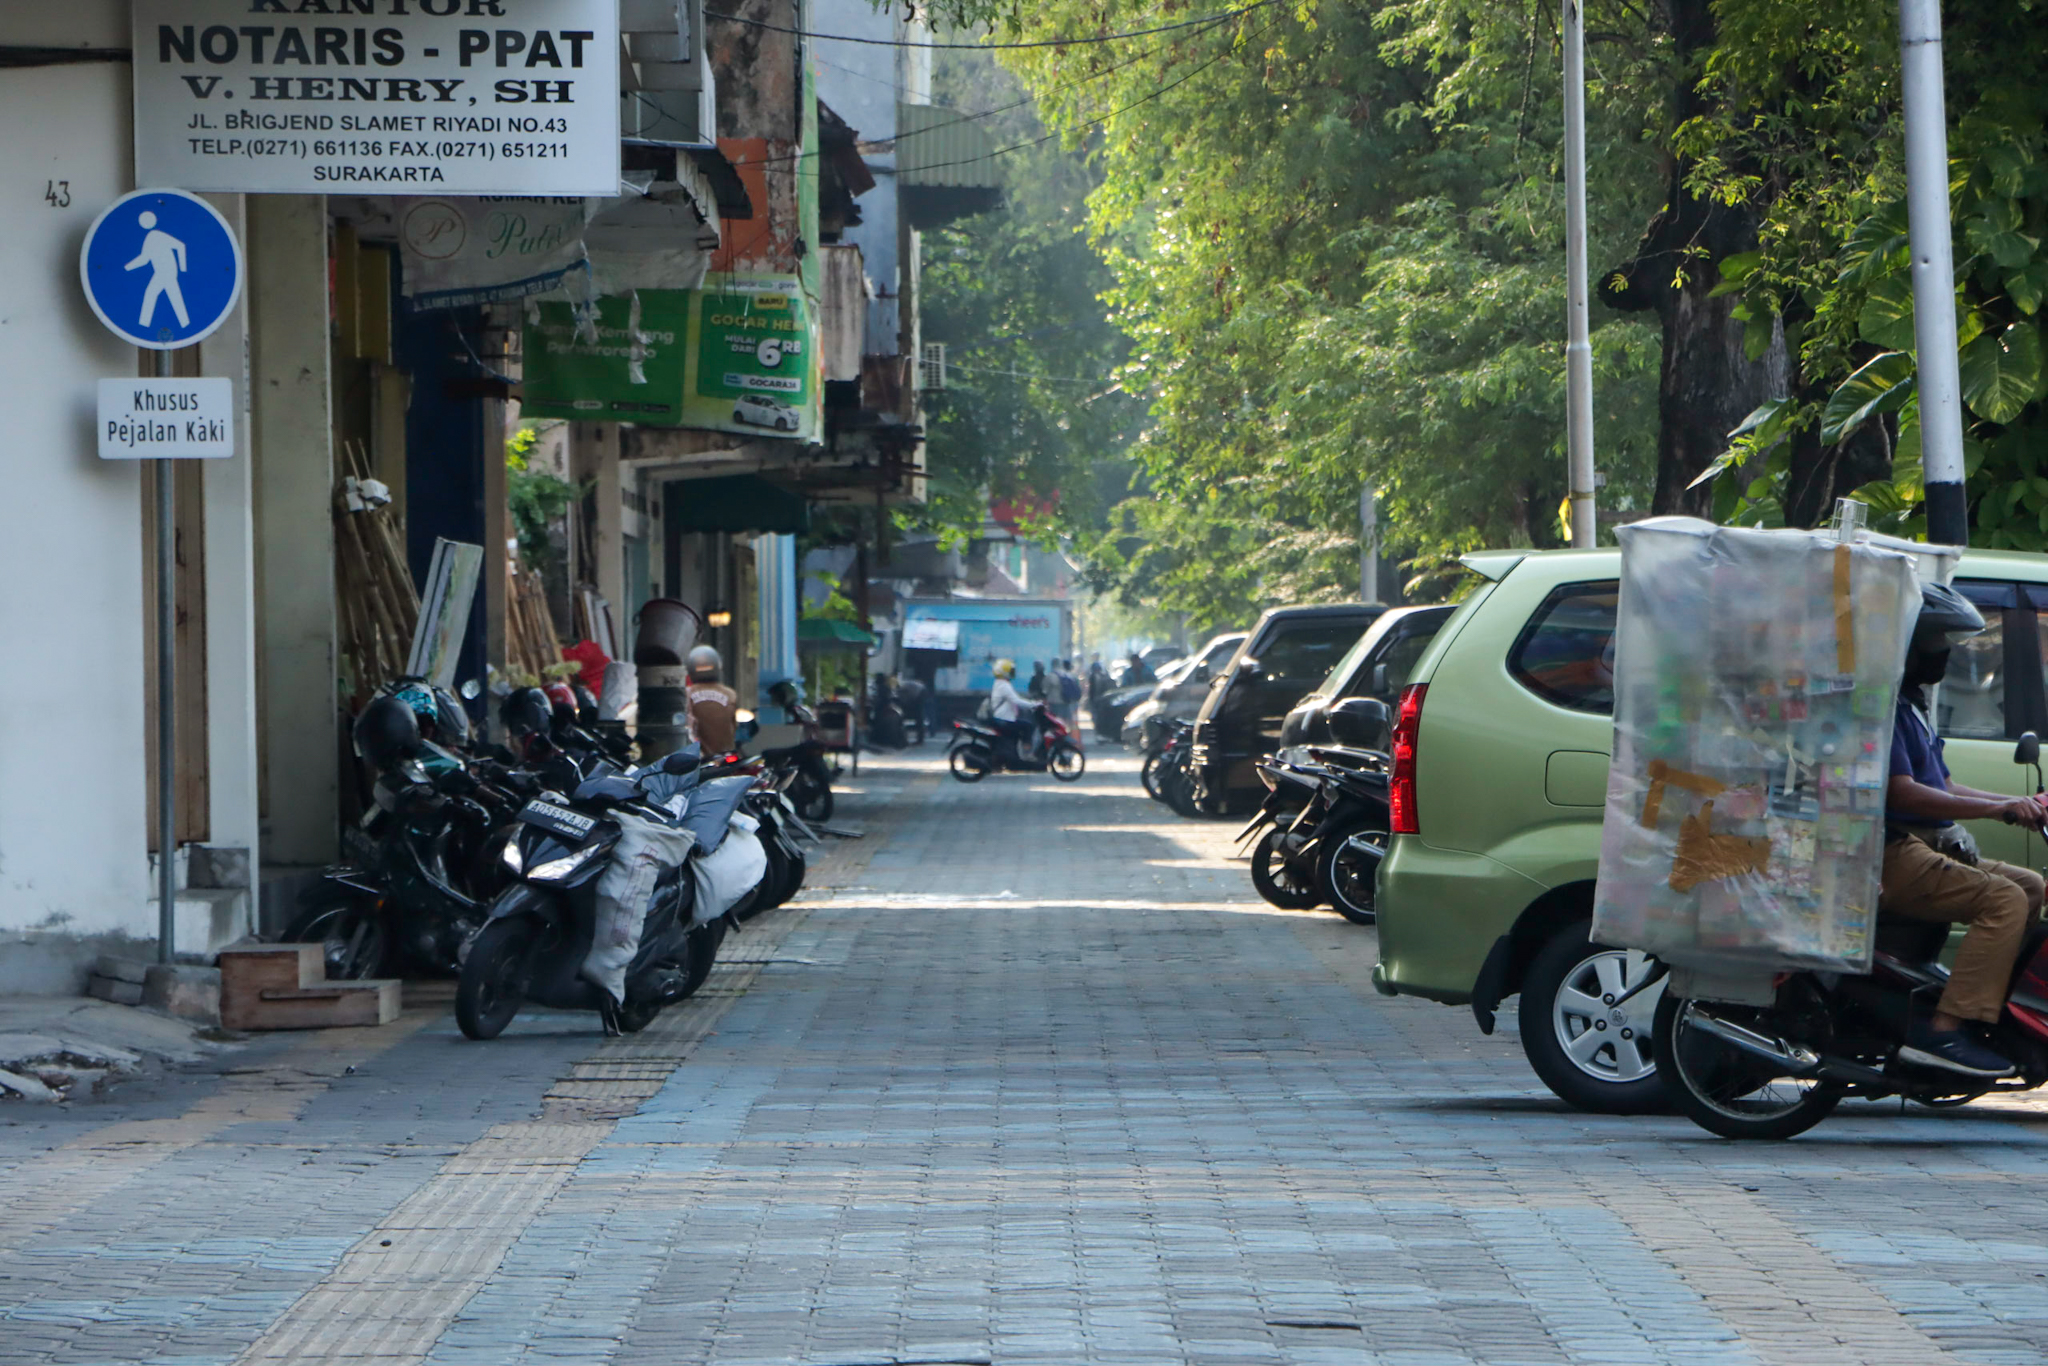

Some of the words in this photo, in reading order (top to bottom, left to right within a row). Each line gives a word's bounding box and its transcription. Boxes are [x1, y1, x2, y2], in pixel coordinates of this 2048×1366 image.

[158, 24, 405, 66] NOTARIS
[423, 48, 439, 57] -
[459, 29, 594, 68] PPAT
[180, 75, 234, 100] V.
[248, 77, 477, 107] HENRY,
[494, 79, 575, 103] SH
[187, 113, 218, 130] JL.
[225, 112, 334, 131] BRIGJEND
[340, 115, 426, 132] SLAMET
[433, 117, 501, 133] RIYADI
[508, 117, 568, 134] NO.43
[188, 139, 307, 159] TELP.(0271)
[313, 140, 382, 157] 661136
[389, 141, 495, 161] FAX.(0271)
[502, 143, 568, 158] 651211
[313, 166, 444, 183] SURAKARTA
[45, 180, 71, 207] 43
[710, 314, 768, 329] GOCAR
[731, 344, 756, 353] DARI
[133, 389, 199, 411] Khusus
[107, 420, 177, 447] Pejalan
[186, 419, 225, 442] Kaki
